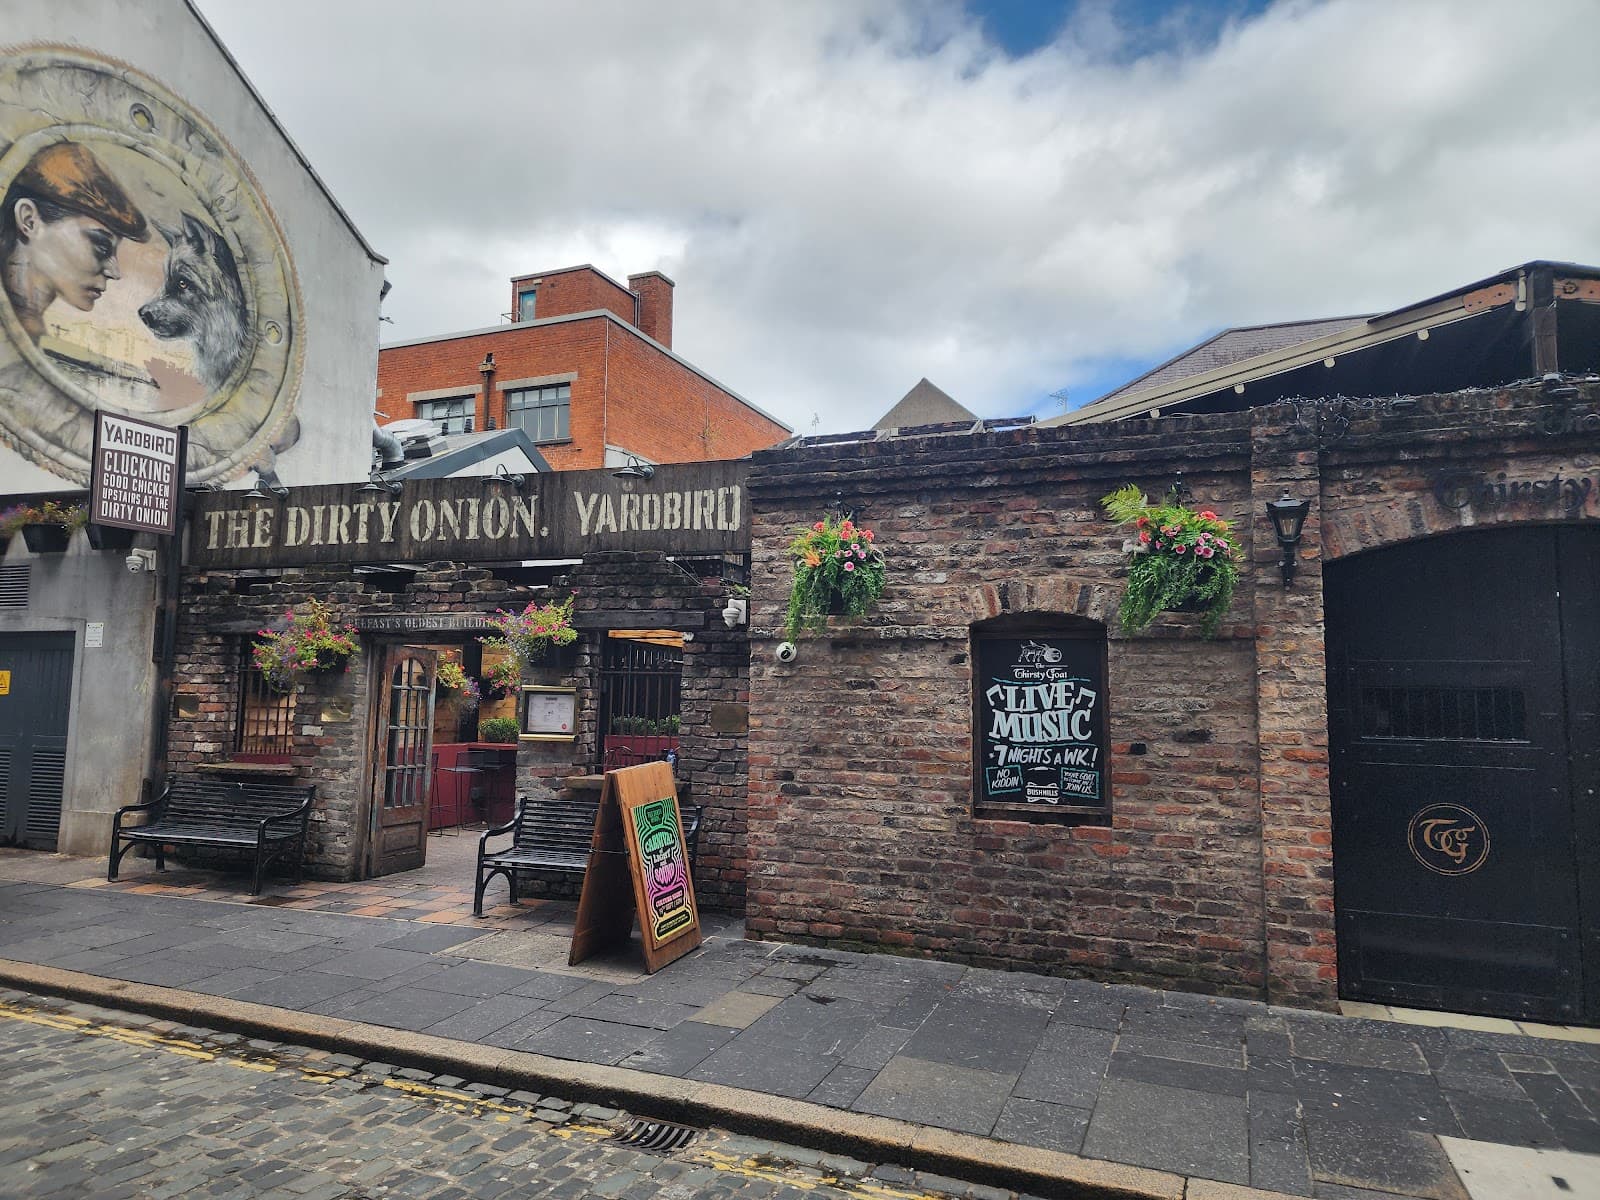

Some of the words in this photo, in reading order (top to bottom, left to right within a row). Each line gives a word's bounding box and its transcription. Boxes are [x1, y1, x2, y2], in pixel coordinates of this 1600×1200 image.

[104, 421, 175, 456] YARDBIRD
[104, 451, 170, 483] CLUCKING
[103, 473, 129, 489] GOOD
[132, 479, 170, 498] CHICKEN
[102, 488, 141, 505] UPSTAIRS
[143, 495, 152, 507] AT
[155, 498, 169, 510] THE
[101, 501, 134, 521] DIRTY
[136, 507, 168, 526] ONION
[574, 484, 741, 537] YARDBIRD
[205, 508, 274, 549] THE
[284, 502, 401, 547] DIRTY
[410, 495, 549, 543] ONION.
[405, 616, 445, 629] OLDEST
[1013, 668, 1046, 680] Thirsty
[1046, 668, 1067, 681] Goat
[1003, 682, 1075, 713] LIVE
[989, 709, 1092, 742] MUSIC
[994, 745, 1008, 766] 7
[1008, 748, 1052, 764] NIGHTS
[1054, 754, 1062, 765] A
[991, 776, 1020, 789] KIDDIN
[996, 768, 1010, 778] NO
[1026, 788, 1059, 796] BUSHMILLS
[1064, 782, 1082, 792] JOIN
[645, 831, 675, 853] CARNIVAL
[654, 862, 675, 885] SOUND
